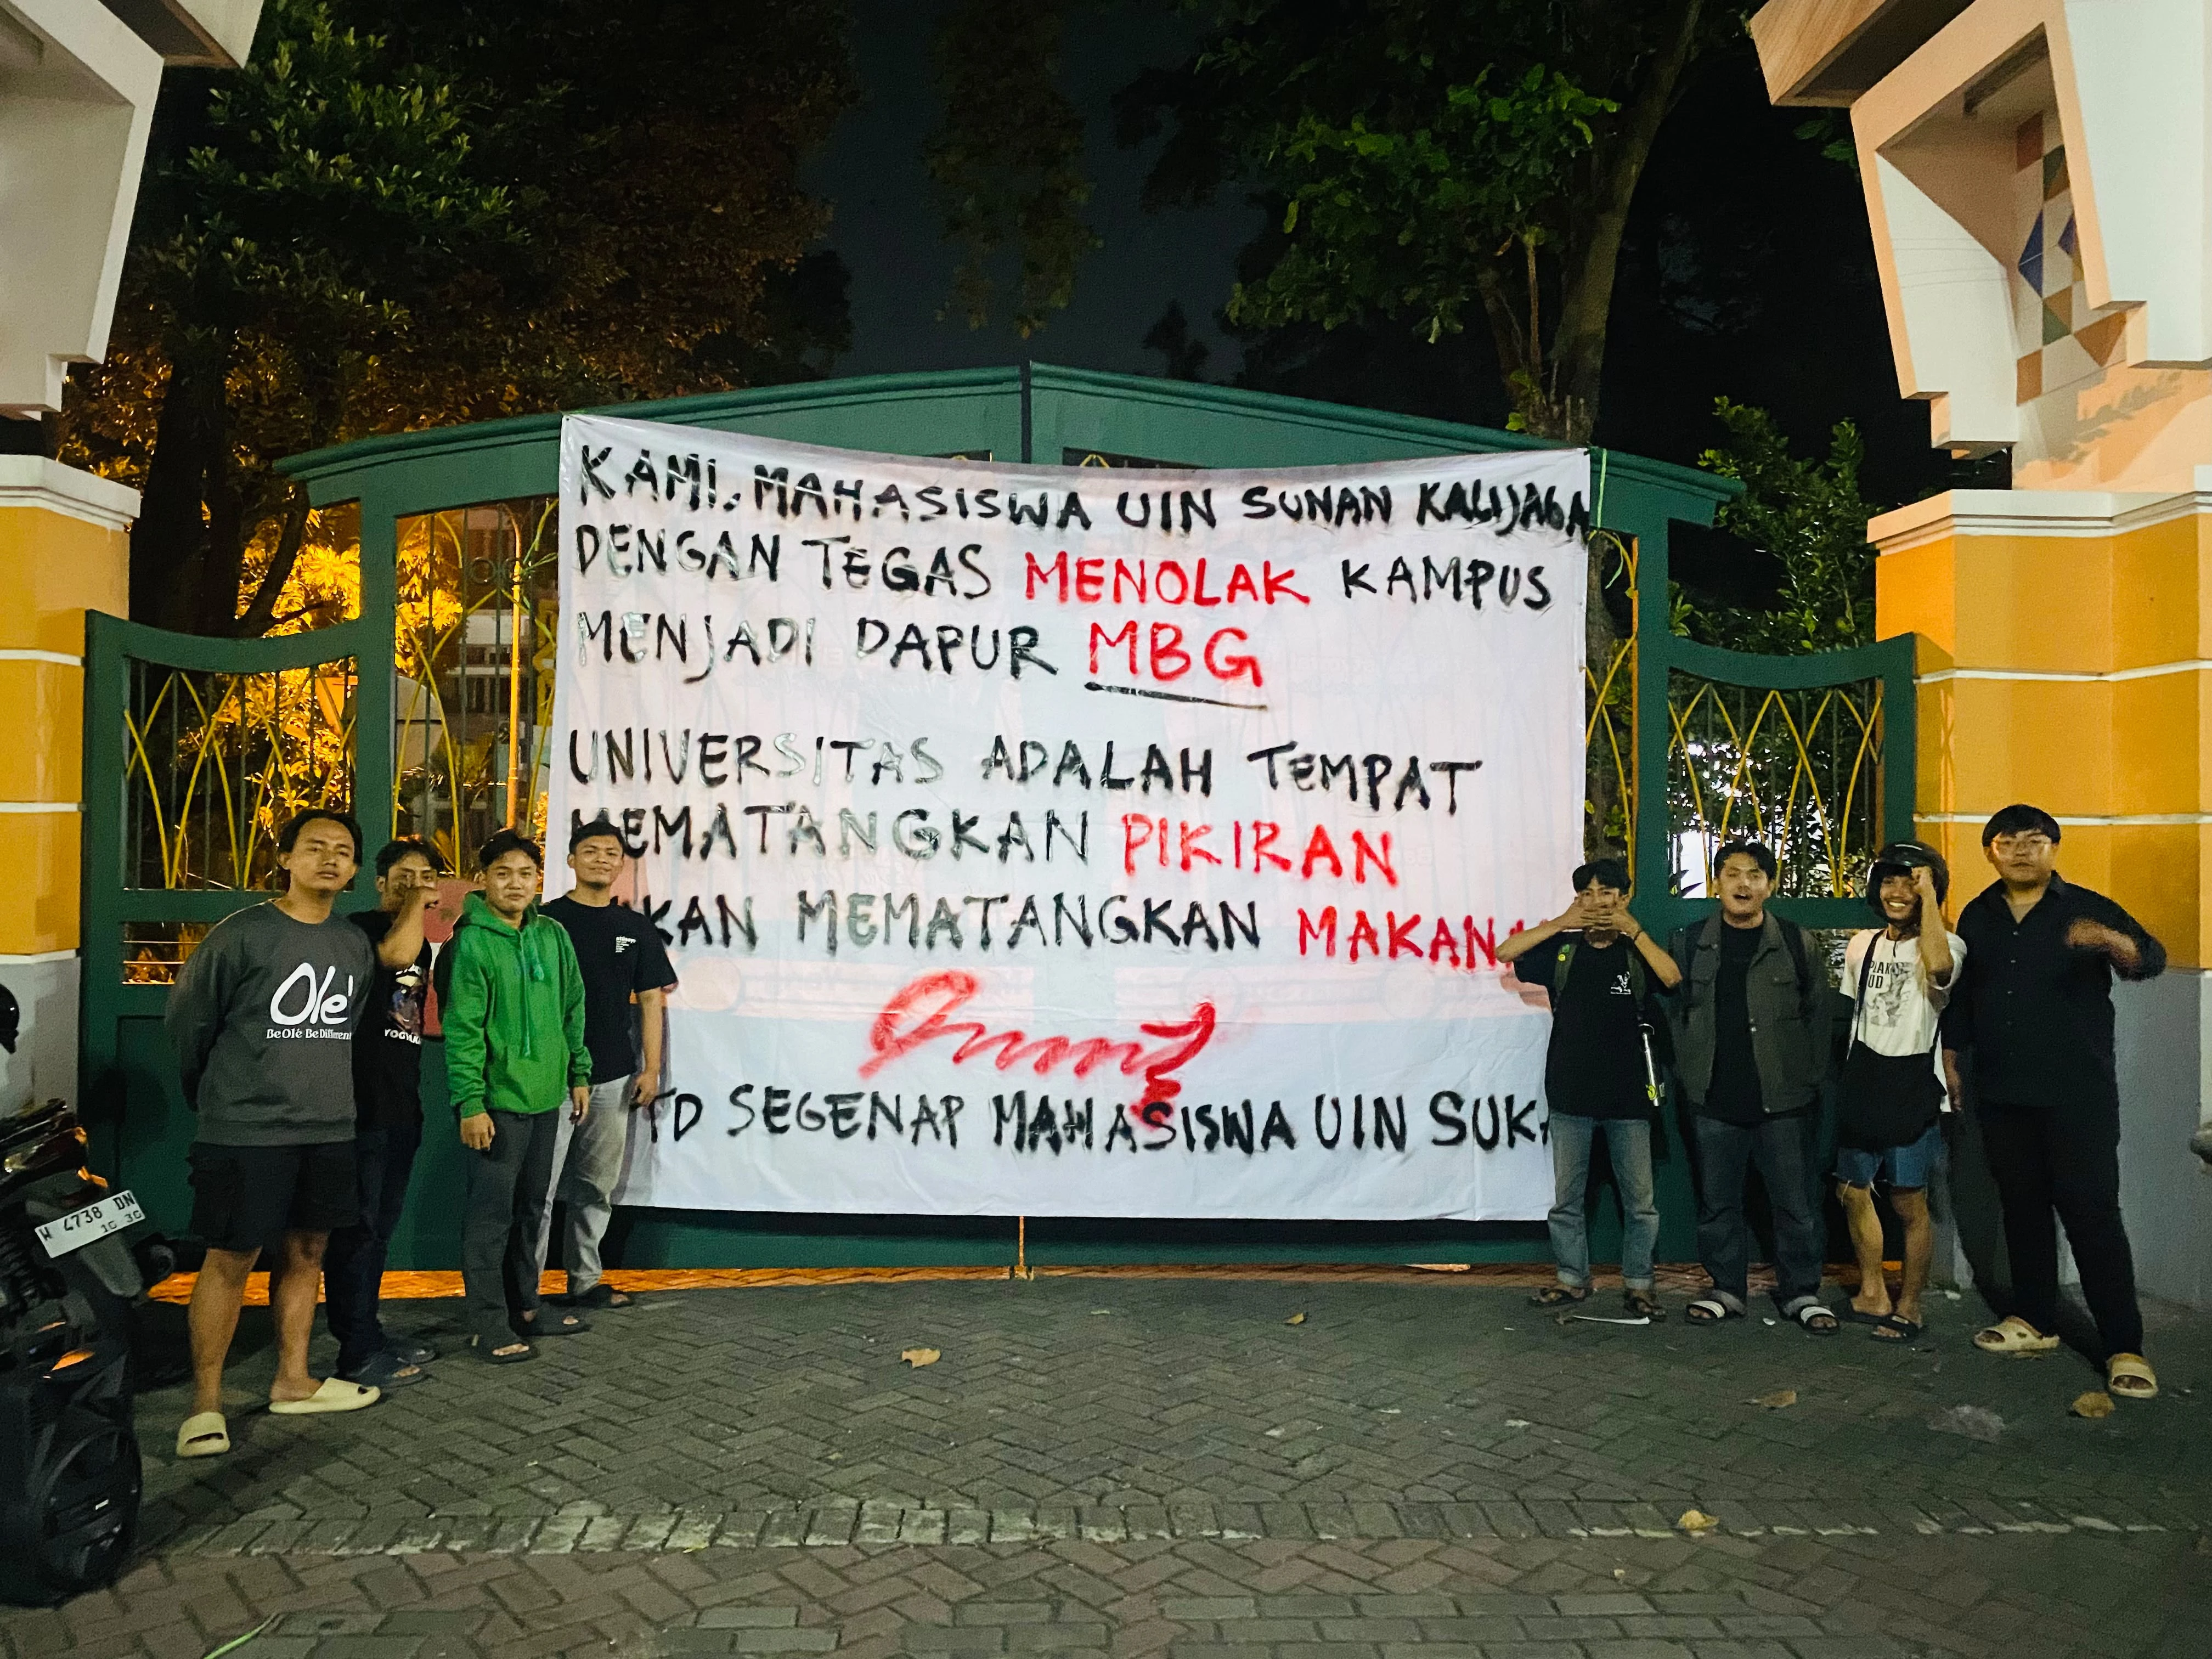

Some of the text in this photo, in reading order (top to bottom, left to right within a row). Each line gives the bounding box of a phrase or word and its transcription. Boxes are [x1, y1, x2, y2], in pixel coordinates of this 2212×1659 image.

[754, 464, 1092, 531] MAHASISWA
[1116, 488, 1216, 533] UIN
[1242, 485, 1392, 528] SUNAN
[575, 524, 1551, 610] DENGAN TEGAS MENOLAK KAMPUS
[577, 610, 815, 684] MENJADI
[857, 617, 1058, 679] DAPUR
[1088, 619, 1263, 687] MBG
[569, 727, 1482, 815] UNIVERSITAS ADALAH TEMPAT
[1121, 813, 1398, 887] PIKIRAN
[609, 889, 1544, 970] KAN MEMATANGKAN MAKAN
[727, 1084, 964, 1149] SEGENAP
[992, 1091, 1296, 1156] MAHASISWA
[1314, 1094, 1407, 1152] UIN
[112, 1193, 136, 1210] DN
